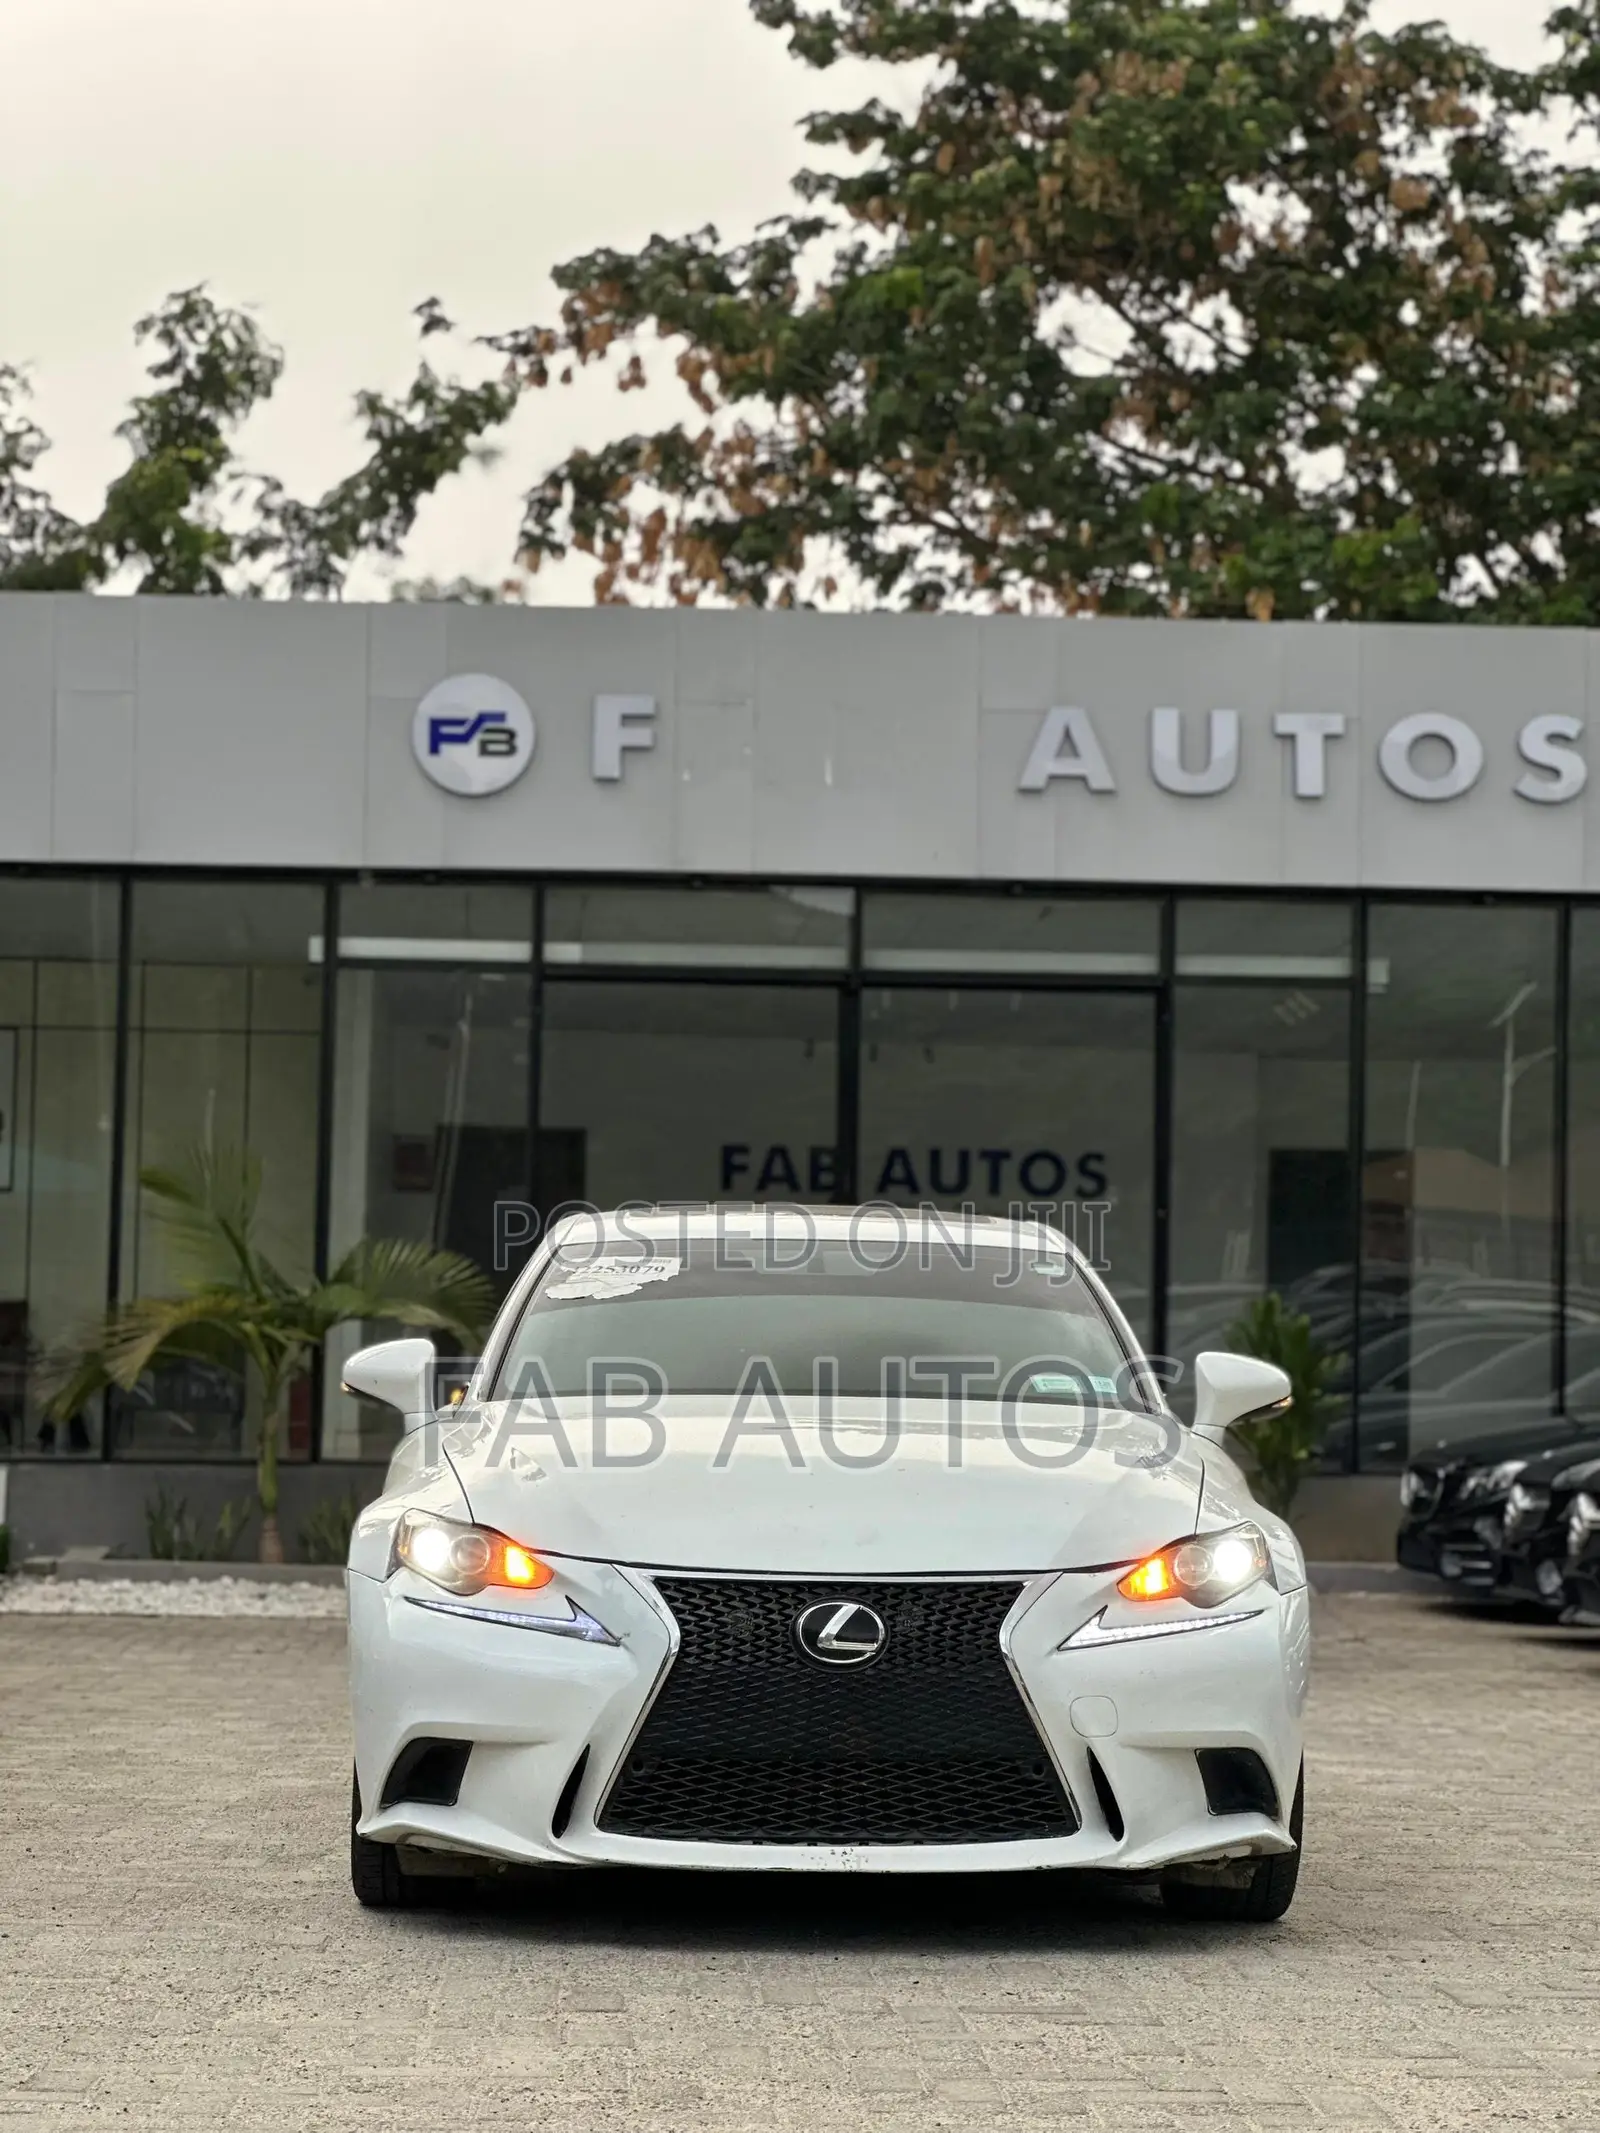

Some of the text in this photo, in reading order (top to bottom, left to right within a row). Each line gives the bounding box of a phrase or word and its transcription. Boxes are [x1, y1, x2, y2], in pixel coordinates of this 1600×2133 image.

[592, 694, 1590, 804] F AUTOS
[720, 1144, 1109, 1200] FAB AUTOS
